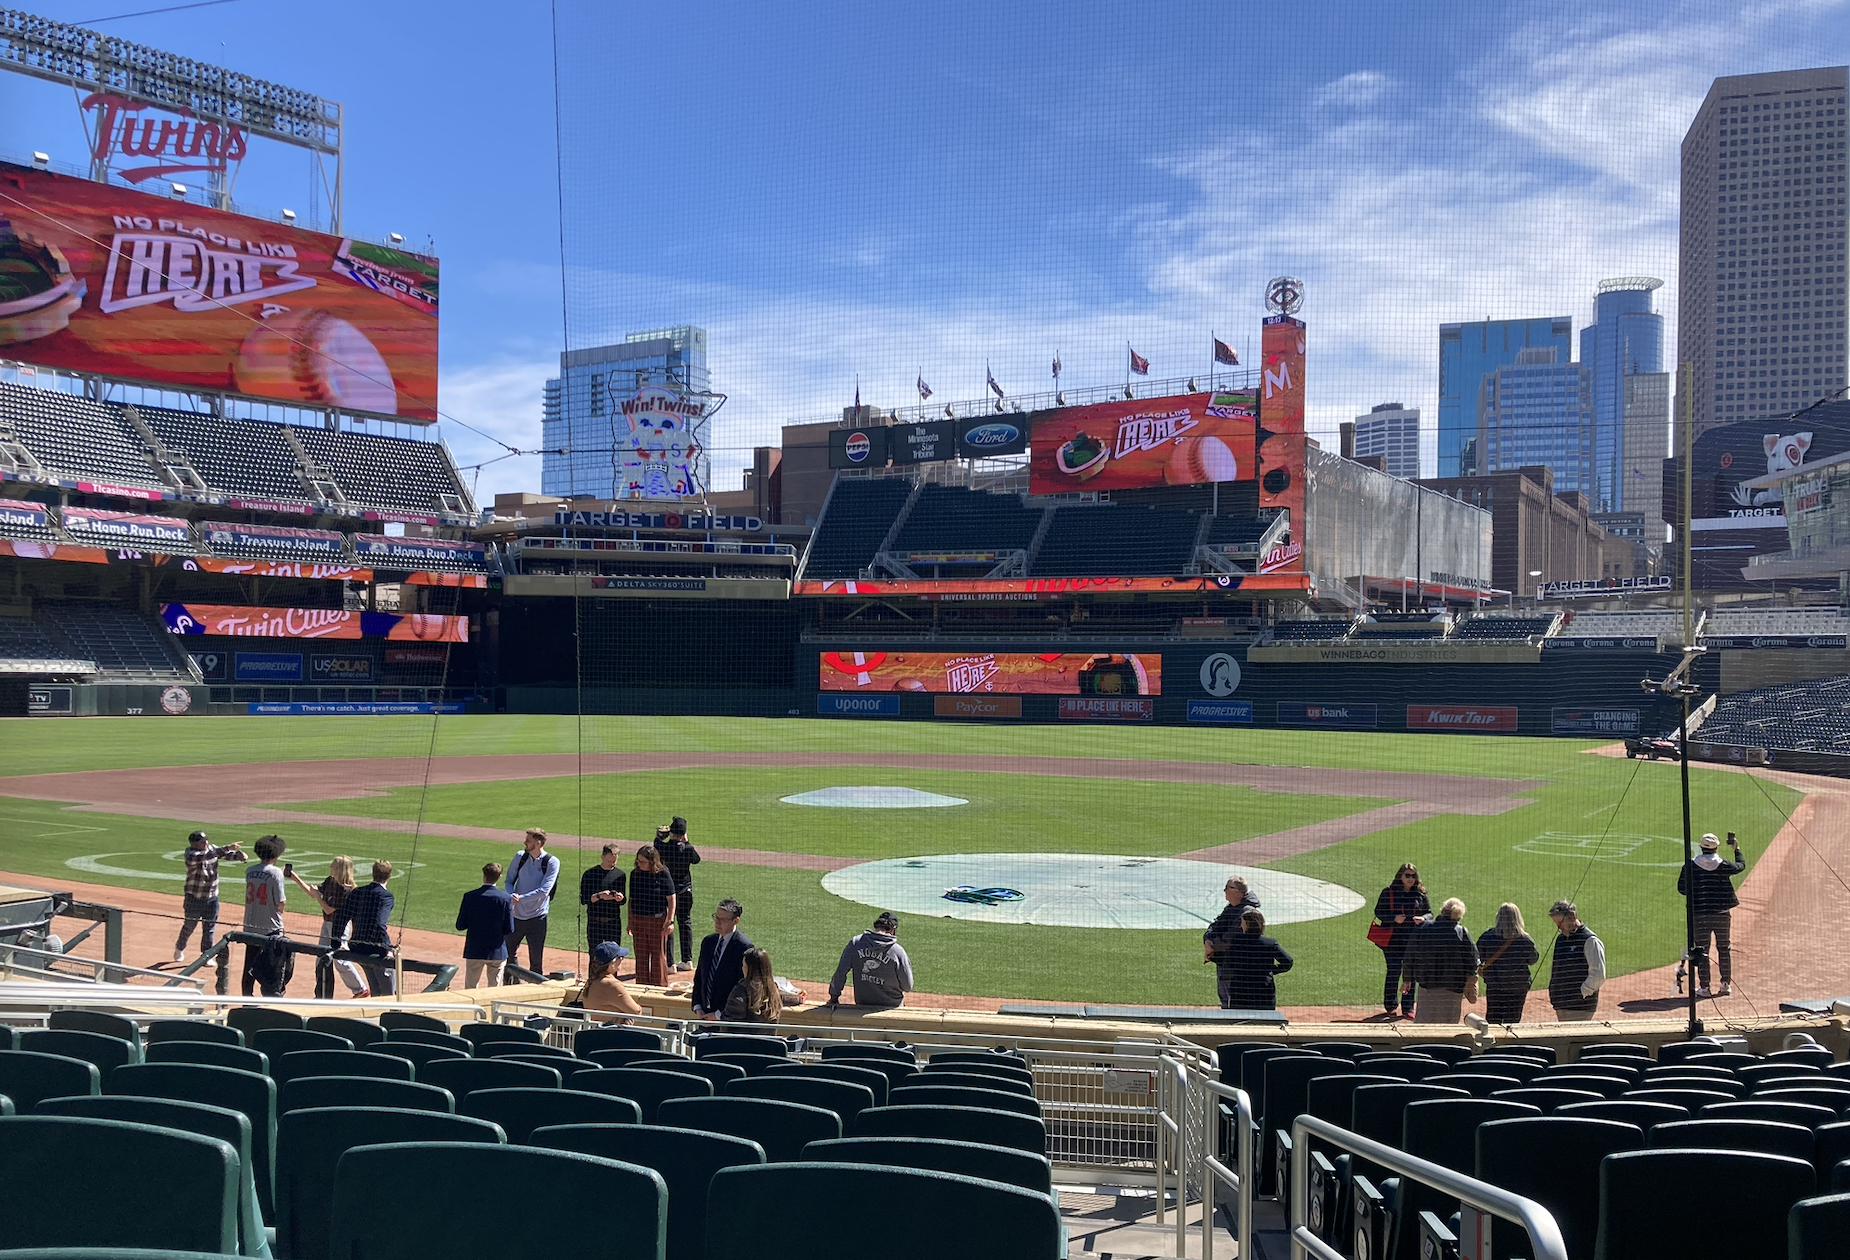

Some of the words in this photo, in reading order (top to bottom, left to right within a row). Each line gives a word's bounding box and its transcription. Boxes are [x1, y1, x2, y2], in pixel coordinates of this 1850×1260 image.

[82, 93, 247, 162] Twins
[113, 215, 153, 231] NO
[158, 219, 242, 250] PLACE
[246, 241, 298, 258] LIKE
[349, 260, 437, 305] TARGET
[1264, 361, 1293, 400] M
[621, 396, 655, 416] Win!
[657, 397, 706, 417] Twins!
[1213, 406, 1256, 417] TARGET
[915, 427, 927, 435] The
[974, 428, 1008, 445] Ford
[907, 434, 939, 444] Minnesota
[846, 443, 870, 451] PEPSI
[921, 443, 935, 452] Star
[912, 449, 935, 460] Tribune
[240, 499, 278, 511] Treasure
[279, 503, 305, 514] Island
[1728, 507, 1780, 519] TARGET
[558, 511, 661, 528] TARGET
[687, 515, 763, 531] FIELD
[92, 521, 126, 534] Home
[130, 526, 154, 538] Run
[156, 527, 184, 541] Deck
[240, 535, 291, 549] Treasure
[295, 540, 330, 551] Island
[393, 547, 424, 558] Home
[426, 550, 446, 560] Run
[449, 551, 474, 561] Deck
[617, 579, 645, 587] DELTA
[1540, 578, 1598, 590] TARGET
[1621, 575, 1672, 588] FIELD
[1005, 592, 1037, 600] AUCTIONS
[1545, 637, 1575, 648] Corona
[1583, 637, 1615, 648] Corona
[1622, 636, 1655, 648] Corona
[1699, 637, 1733, 646] Corona
[1752, 637, 1788, 647] Corona
[1807, 636, 1845, 647] Corona
[956, 656, 979, 665] PLACE
[980, 653, 995, 662] LIKE
[1320, 650, 1386, 659] WINNEBAGO
[1386, 650, 1457, 660] INDUSTRIES
[239, 662, 299, 671] PROGRESSIVE
[372, 706, 389, 714] great
[835, 698, 881, 711] uponor
[956, 699, 998, 714] Paycor
[1077, 701, 1104, 712] PLACE
[1106, 701, 1119, 712] LIKE
[1121, 702, 1144, 713] HERE
[1190, 706, 1248, 717] PROGRESSIVE
[1322, 706, 1349, 718] bank
[1593, 711, 1637, 722] CHANGING
[1594, 721, 1611, 731] THE
[1612, 721, 1637, 732] GAME
[246, 881, 267, 906] 34
